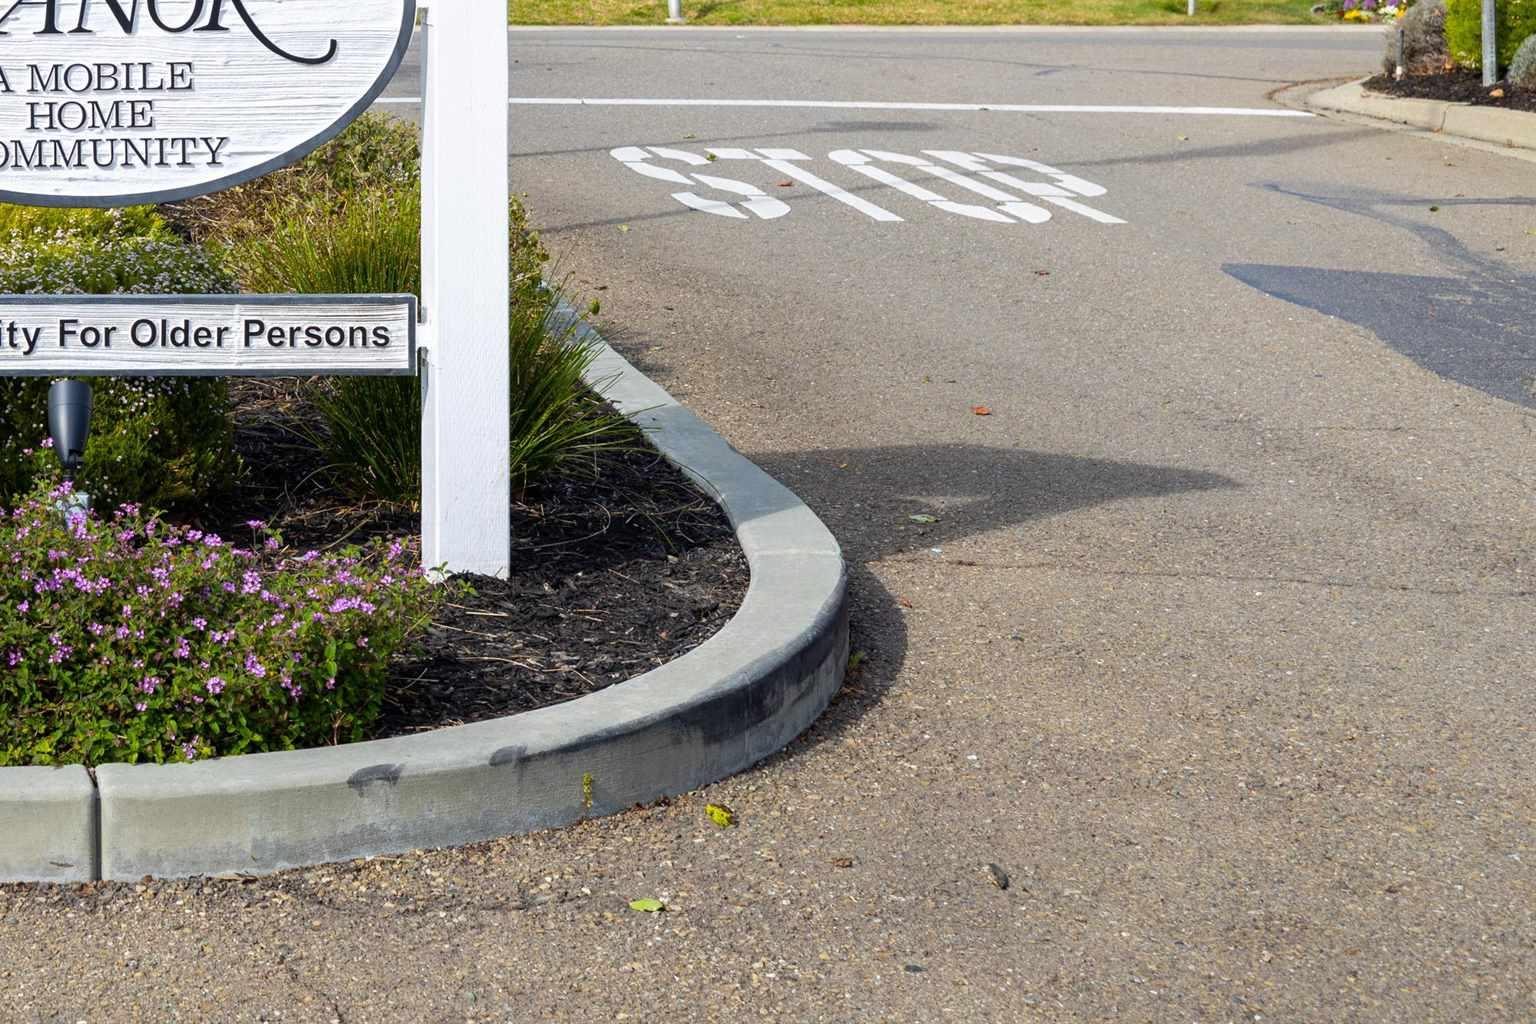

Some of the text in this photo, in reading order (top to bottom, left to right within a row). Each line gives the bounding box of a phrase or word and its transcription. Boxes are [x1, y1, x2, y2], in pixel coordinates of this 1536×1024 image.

[26, 62, 193, 93] MOBILE
[25, 100, 154, 130] HOME
[609, 146, 1129, 224] STOP
[58, 318, 118, 349] For
[130, 318, 230, 349] Older
[243, 318, 391, 349] Persons
